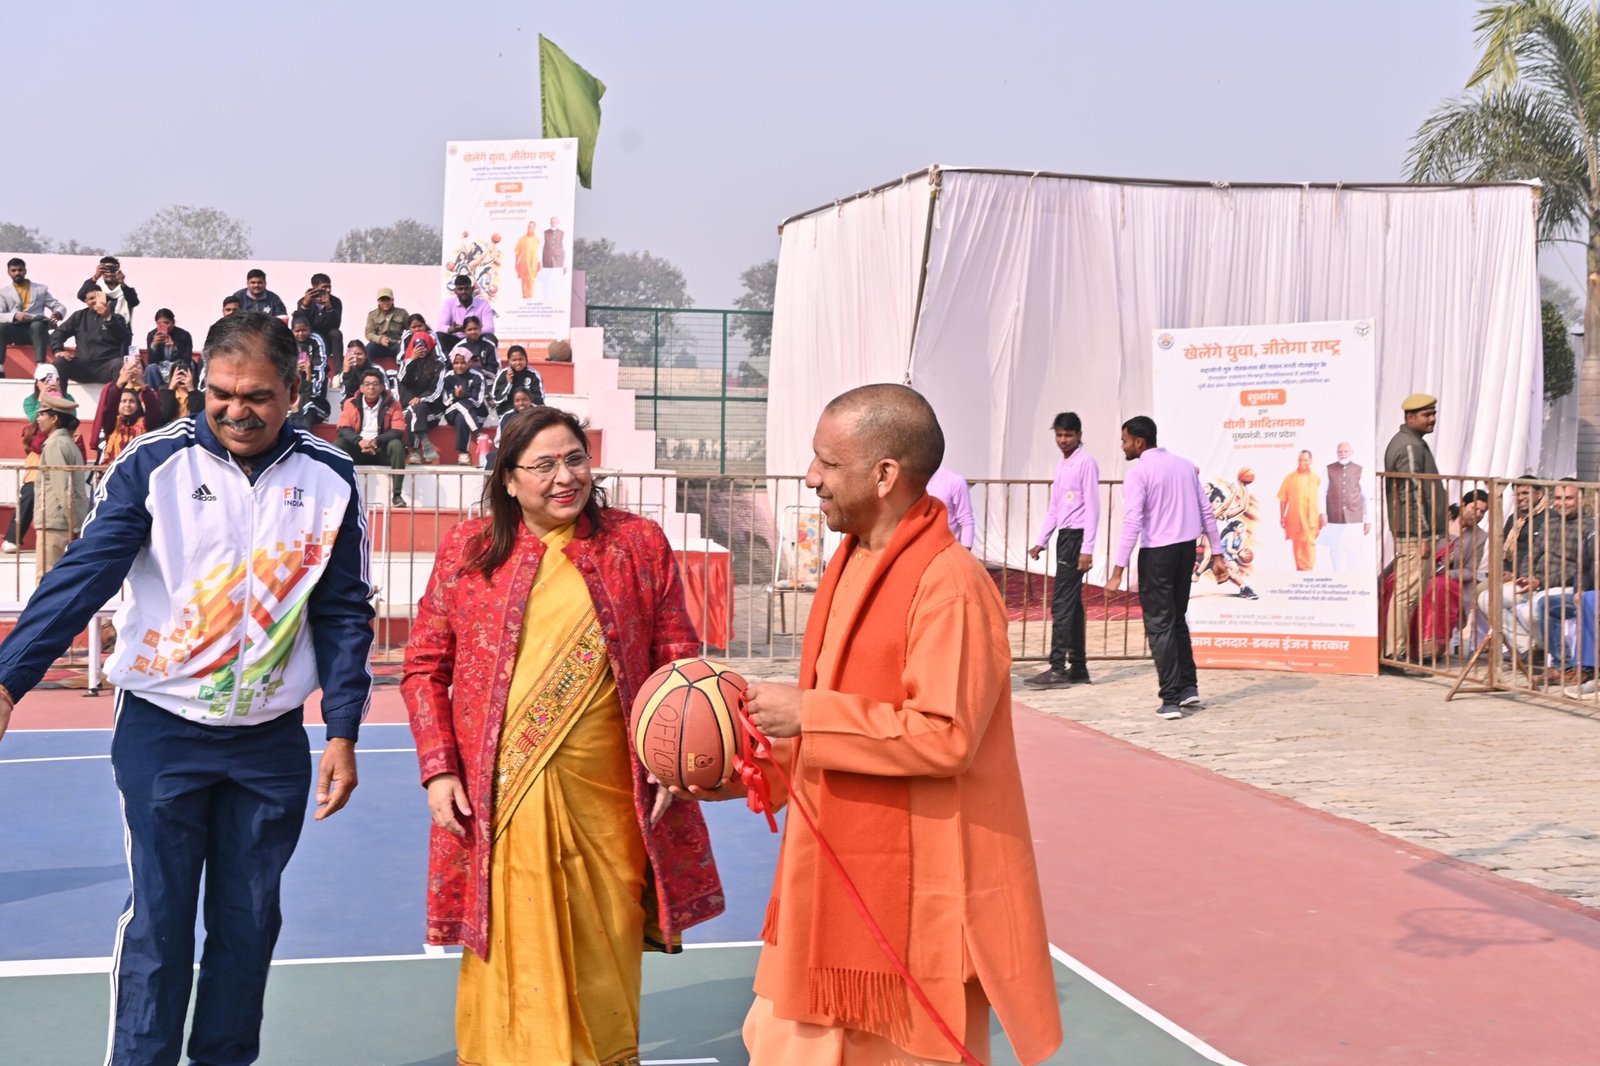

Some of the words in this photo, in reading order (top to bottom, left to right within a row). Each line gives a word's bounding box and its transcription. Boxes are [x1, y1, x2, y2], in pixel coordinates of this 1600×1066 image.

[1183, 342, 1223, 360] खेलेंगे
[1225, 344, 1258, 363] युवा,
[1261, 338, 1307, 356] जीतेगा
[1311, 339, 1342, 356] राष्ट्र
[1247, 391, 1279, 405] शुभारंभ
[1223, 417, 1246, 429] योगी
[1248, 417, 1305, 429] आदित्यनाथ
[191, 492, 217, 502] adidas
[284, 499, 304, 507] INDIA
[1311, 639, 1350, 651] सरकार
